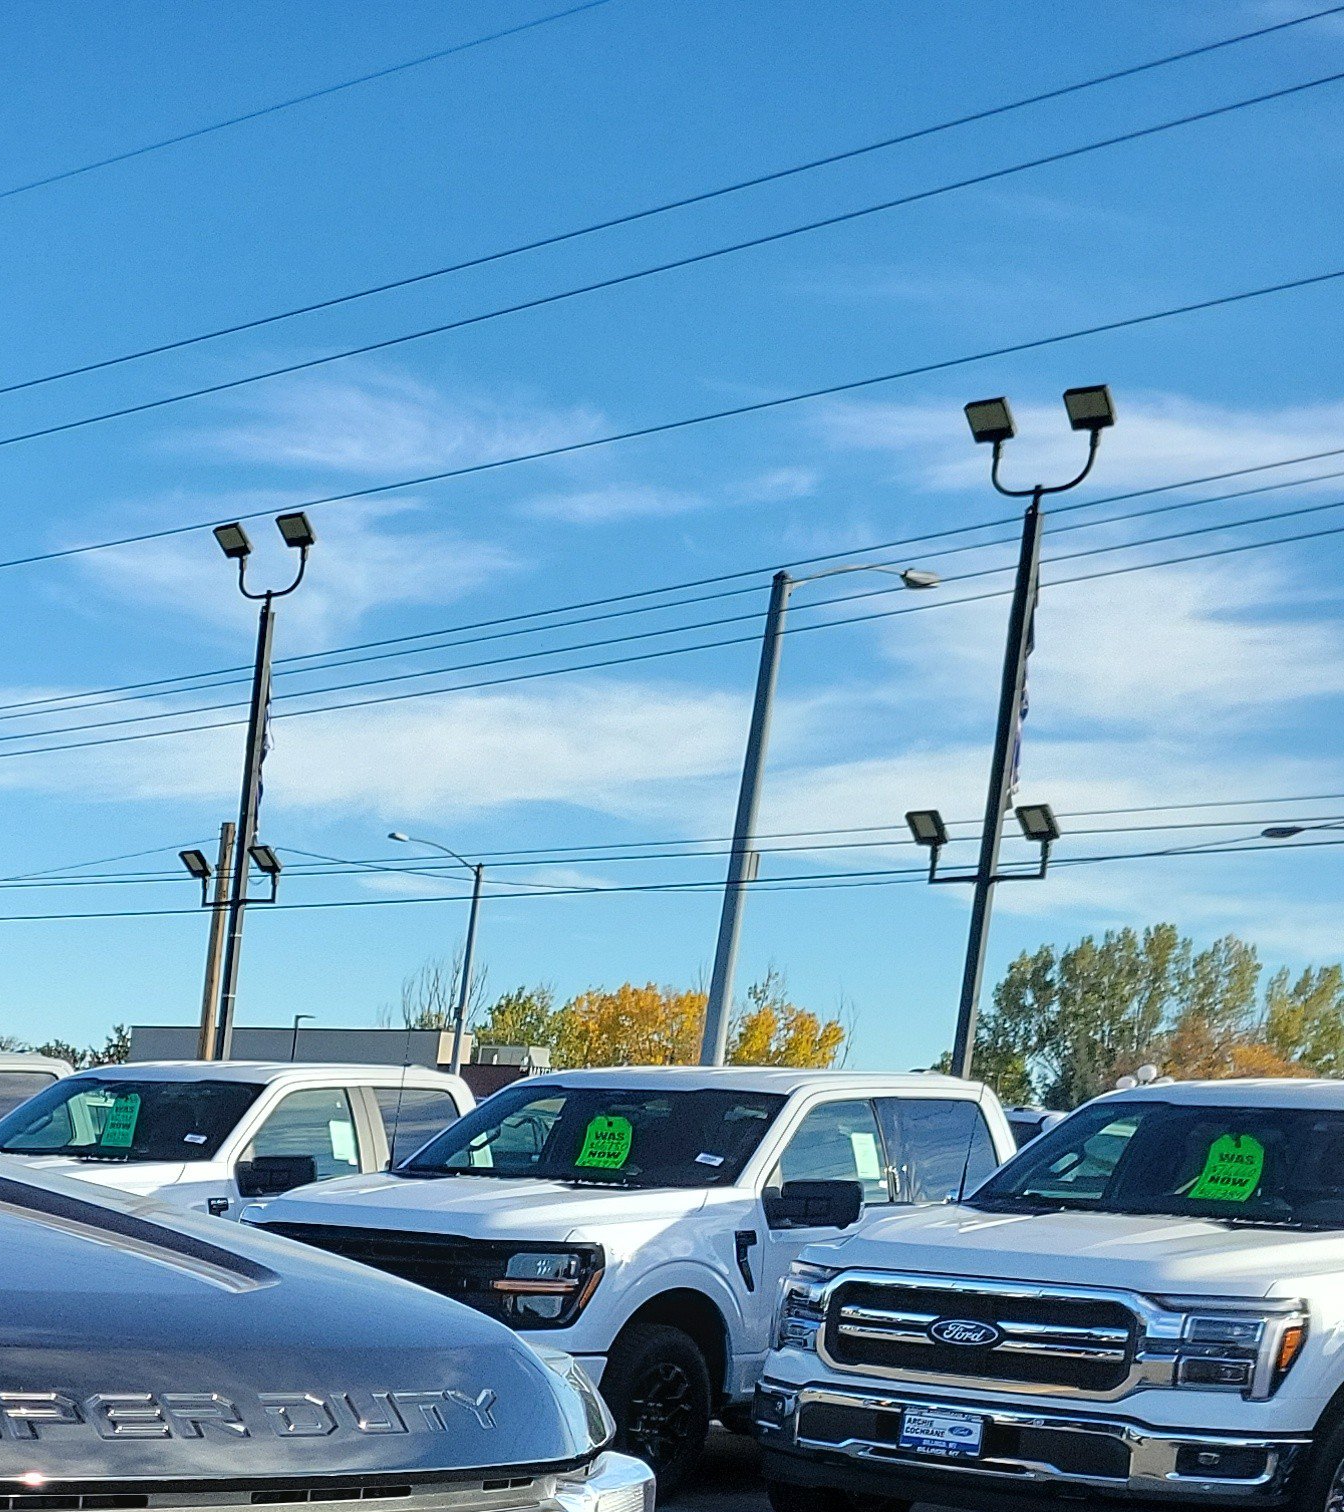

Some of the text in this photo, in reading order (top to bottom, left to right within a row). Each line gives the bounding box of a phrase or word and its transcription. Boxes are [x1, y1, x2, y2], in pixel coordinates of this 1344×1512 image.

[595, 1131, 625, 1141] WAS
[588, 1150, 622, 1159] NOW
[1218, 1152, 1254, 1165] WAS
[1208, 1175, 1251, 1187] NOW
[943, 1323, 986, 1342] Ford
[256, 1387, 499, 1437] DUTY
[907, 1417, 935, 1427] ARCHIE
[905, 1426, 946, 1438] COCHRANE
